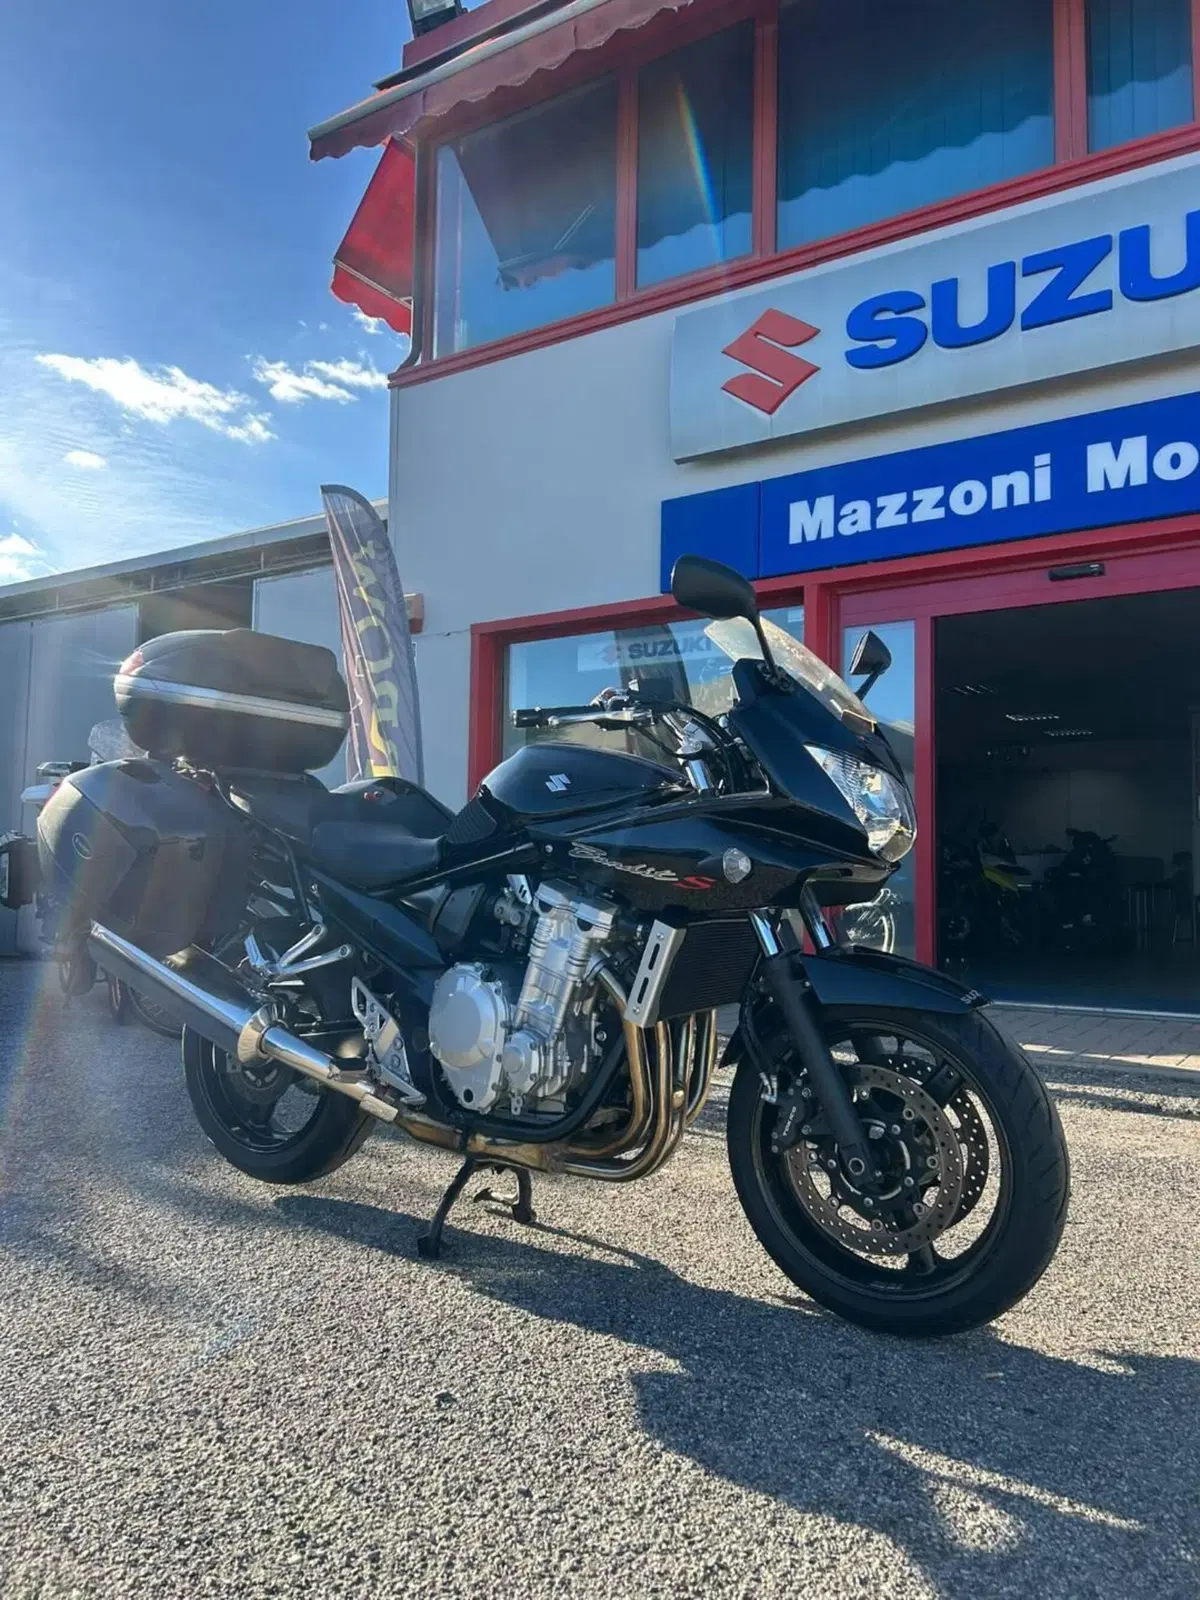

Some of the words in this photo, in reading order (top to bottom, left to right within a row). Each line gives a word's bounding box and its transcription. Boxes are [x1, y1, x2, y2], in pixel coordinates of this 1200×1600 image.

[845, 209, 1200, 370] SUZU
[788, 453, 1052, 545] Mazzoni
[1086, 435, 1199, 493] Mo
[628, 635, 712, 660] SUZUKI
